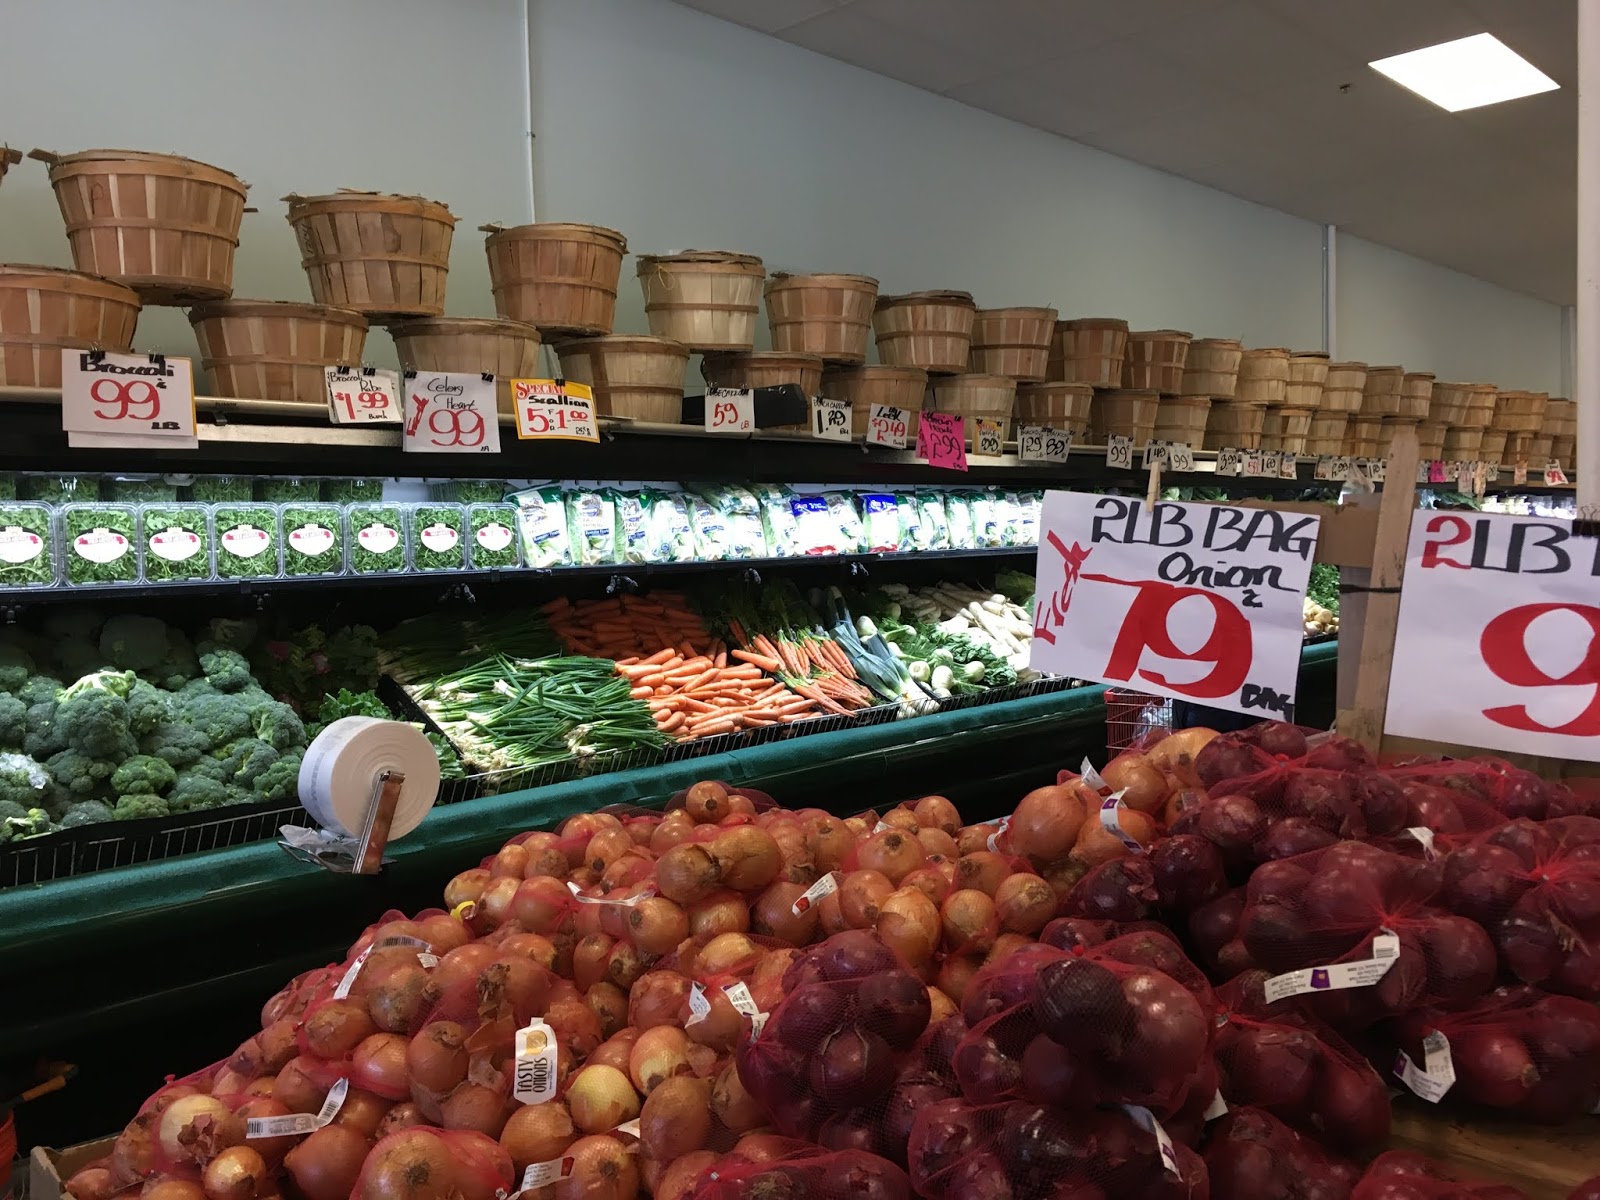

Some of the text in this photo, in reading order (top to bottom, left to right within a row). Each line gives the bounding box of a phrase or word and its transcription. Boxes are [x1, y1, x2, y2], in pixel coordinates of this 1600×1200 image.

[330, 370, 362, 382] Broccoli
[360, 380, 382, 392] Rabe
[516, 382, 566, 399] SPECIAL
[528, 395, 589, 408] Scallion
[713, 402, 739, 427] 59
[429, 409, 485, 446] 99
[1091, 498, 1319, 560] 2LB BAG
[1421, 515, 1571, 574] 2LB
[1158, 552, 1300, 592] Onion
[1080, 573, 1253, 698] 79
[517, 1059, 533, 1093] TASTY
